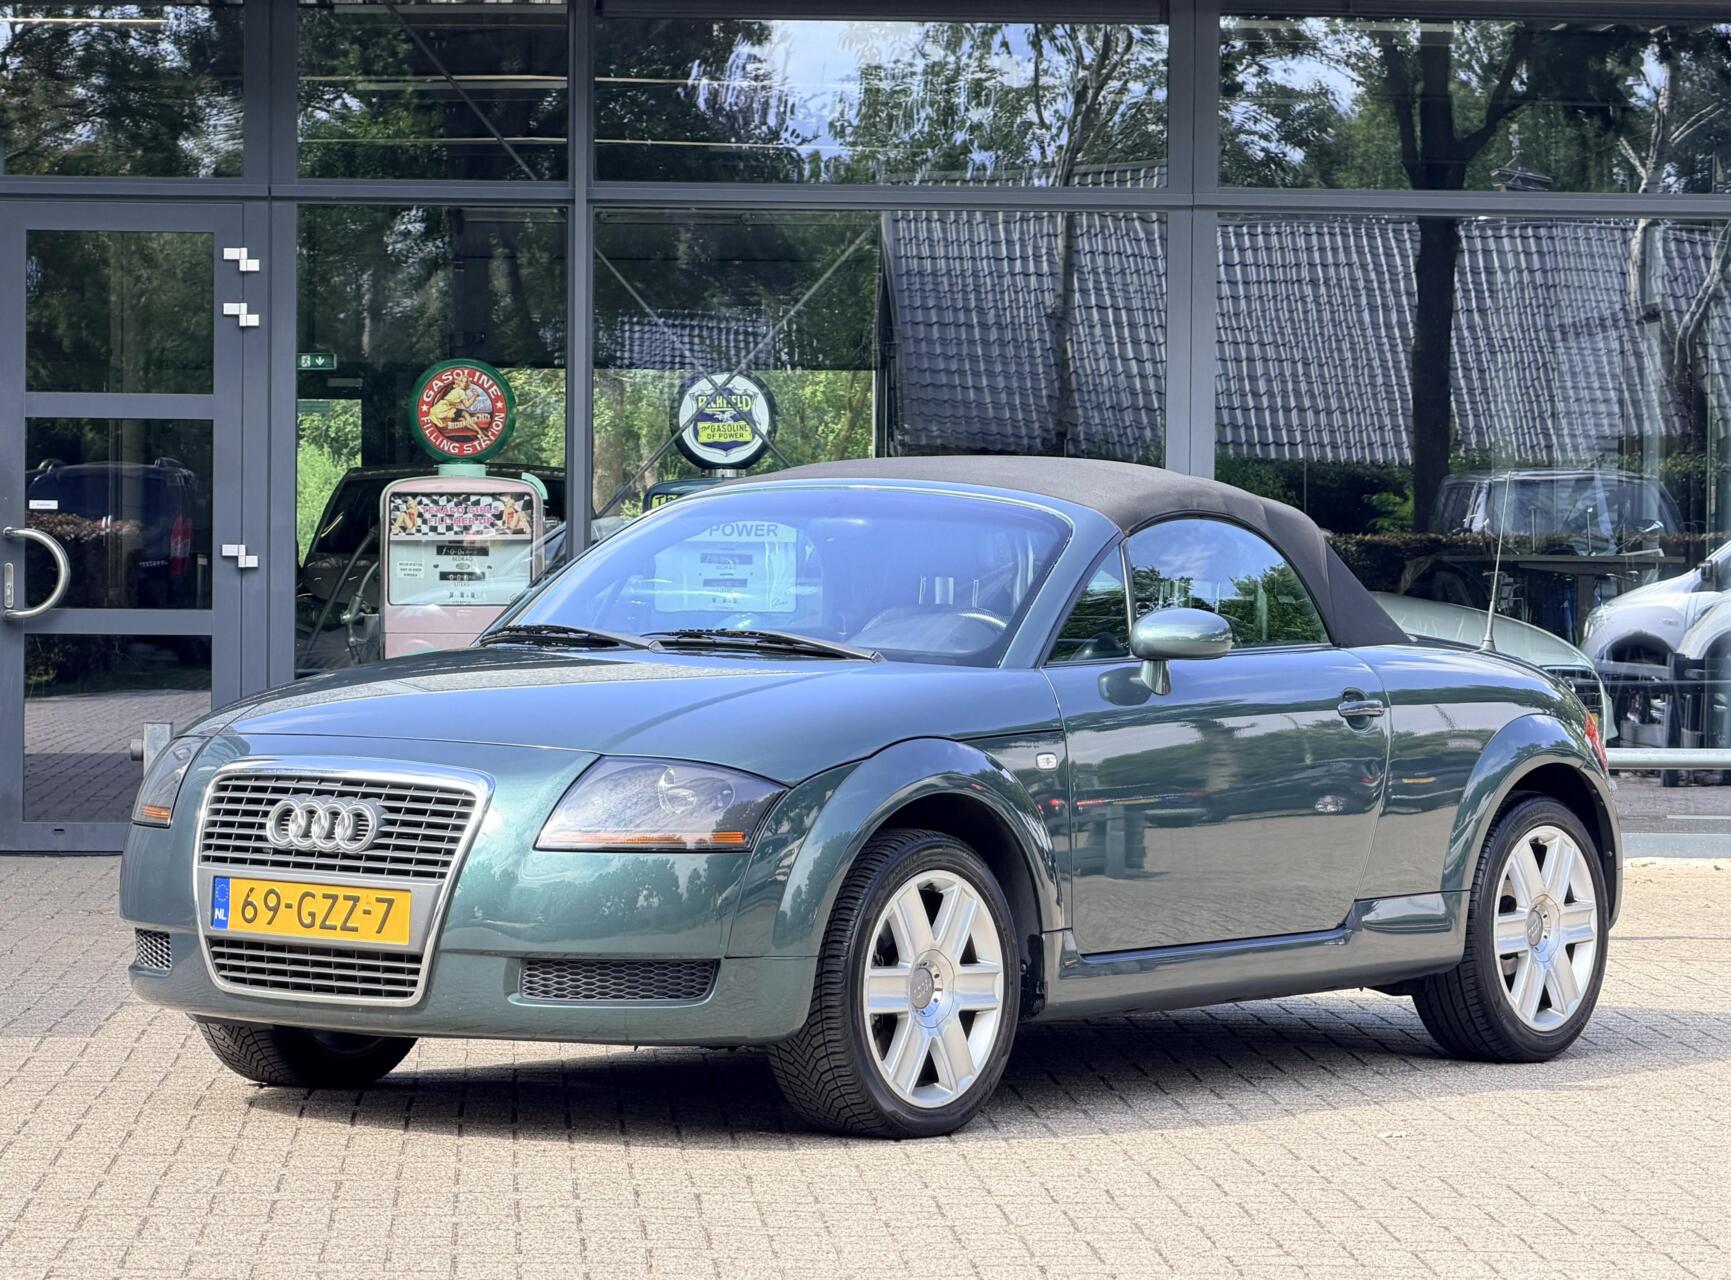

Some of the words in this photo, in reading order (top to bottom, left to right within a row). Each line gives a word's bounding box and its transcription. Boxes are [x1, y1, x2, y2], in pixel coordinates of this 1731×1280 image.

[422, 369, 501, 402] GASOLINE
[421, 415, 460, 453] FILLING
[463, 412, 505, 454] STATION
[710, 424, 749, 433] GASOLINE
[707, 432, 717, 440] OF
[718, 432, 744, 440] POWER
[422, 505, 465, 515] TEXACO
[467, 505, 501, 515] GIRLS
[427, 516, 450, 525] FILL
[708, 523, 778, 537] POWER
[214, 908, 227, 920] NL
[240, 886, 395, 934] 69-GZZ-7
